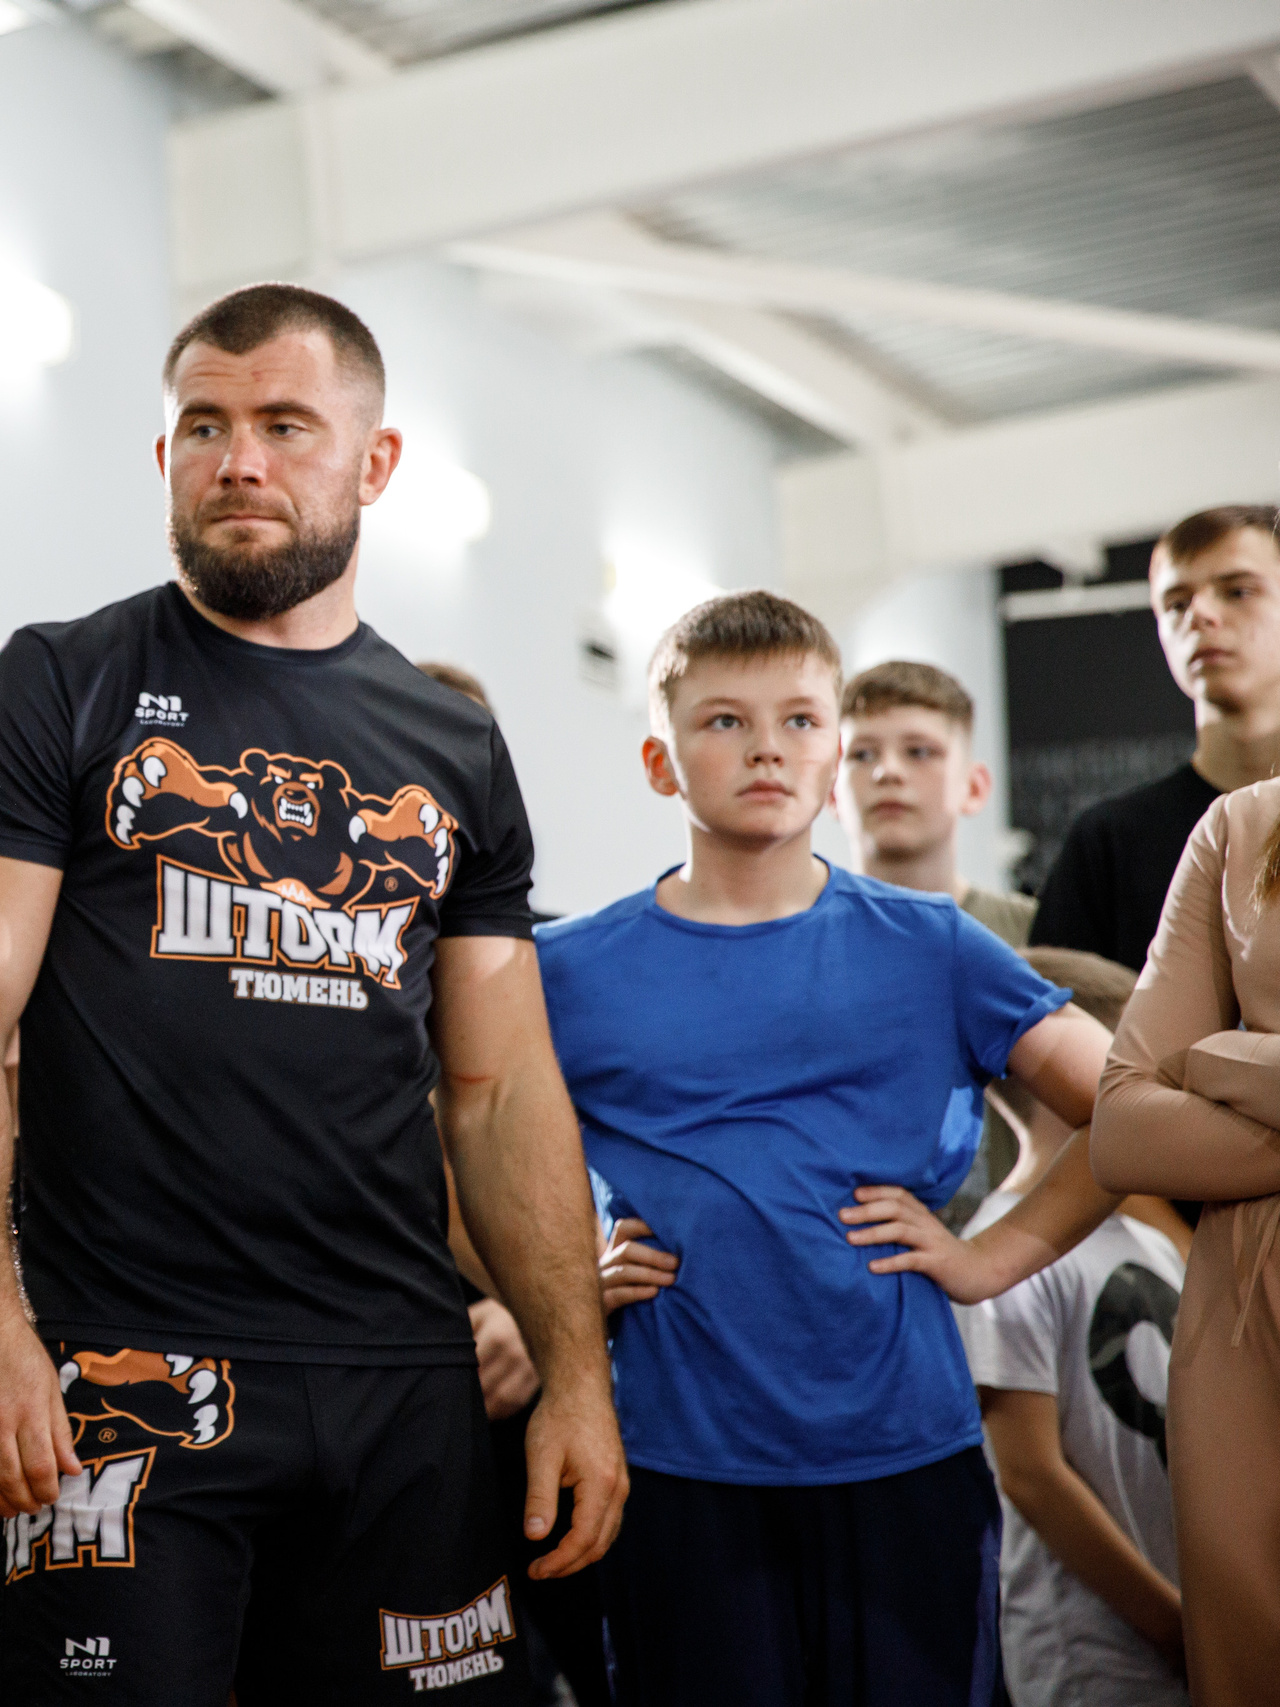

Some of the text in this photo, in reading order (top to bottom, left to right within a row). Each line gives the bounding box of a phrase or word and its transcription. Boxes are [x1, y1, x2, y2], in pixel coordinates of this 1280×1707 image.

[135, 707, 189, 722] SPORT
[154, 860, 417, 986] ШТОРМ
[230, 968, 368, 1010] ТЮМЕНЬ
[382, 1580, 514, 1667] ШТОРМ
[60, 1658, 117, 1670] SPORT
[409, 1648, 505, 1692] ТЮМЕНЬ
